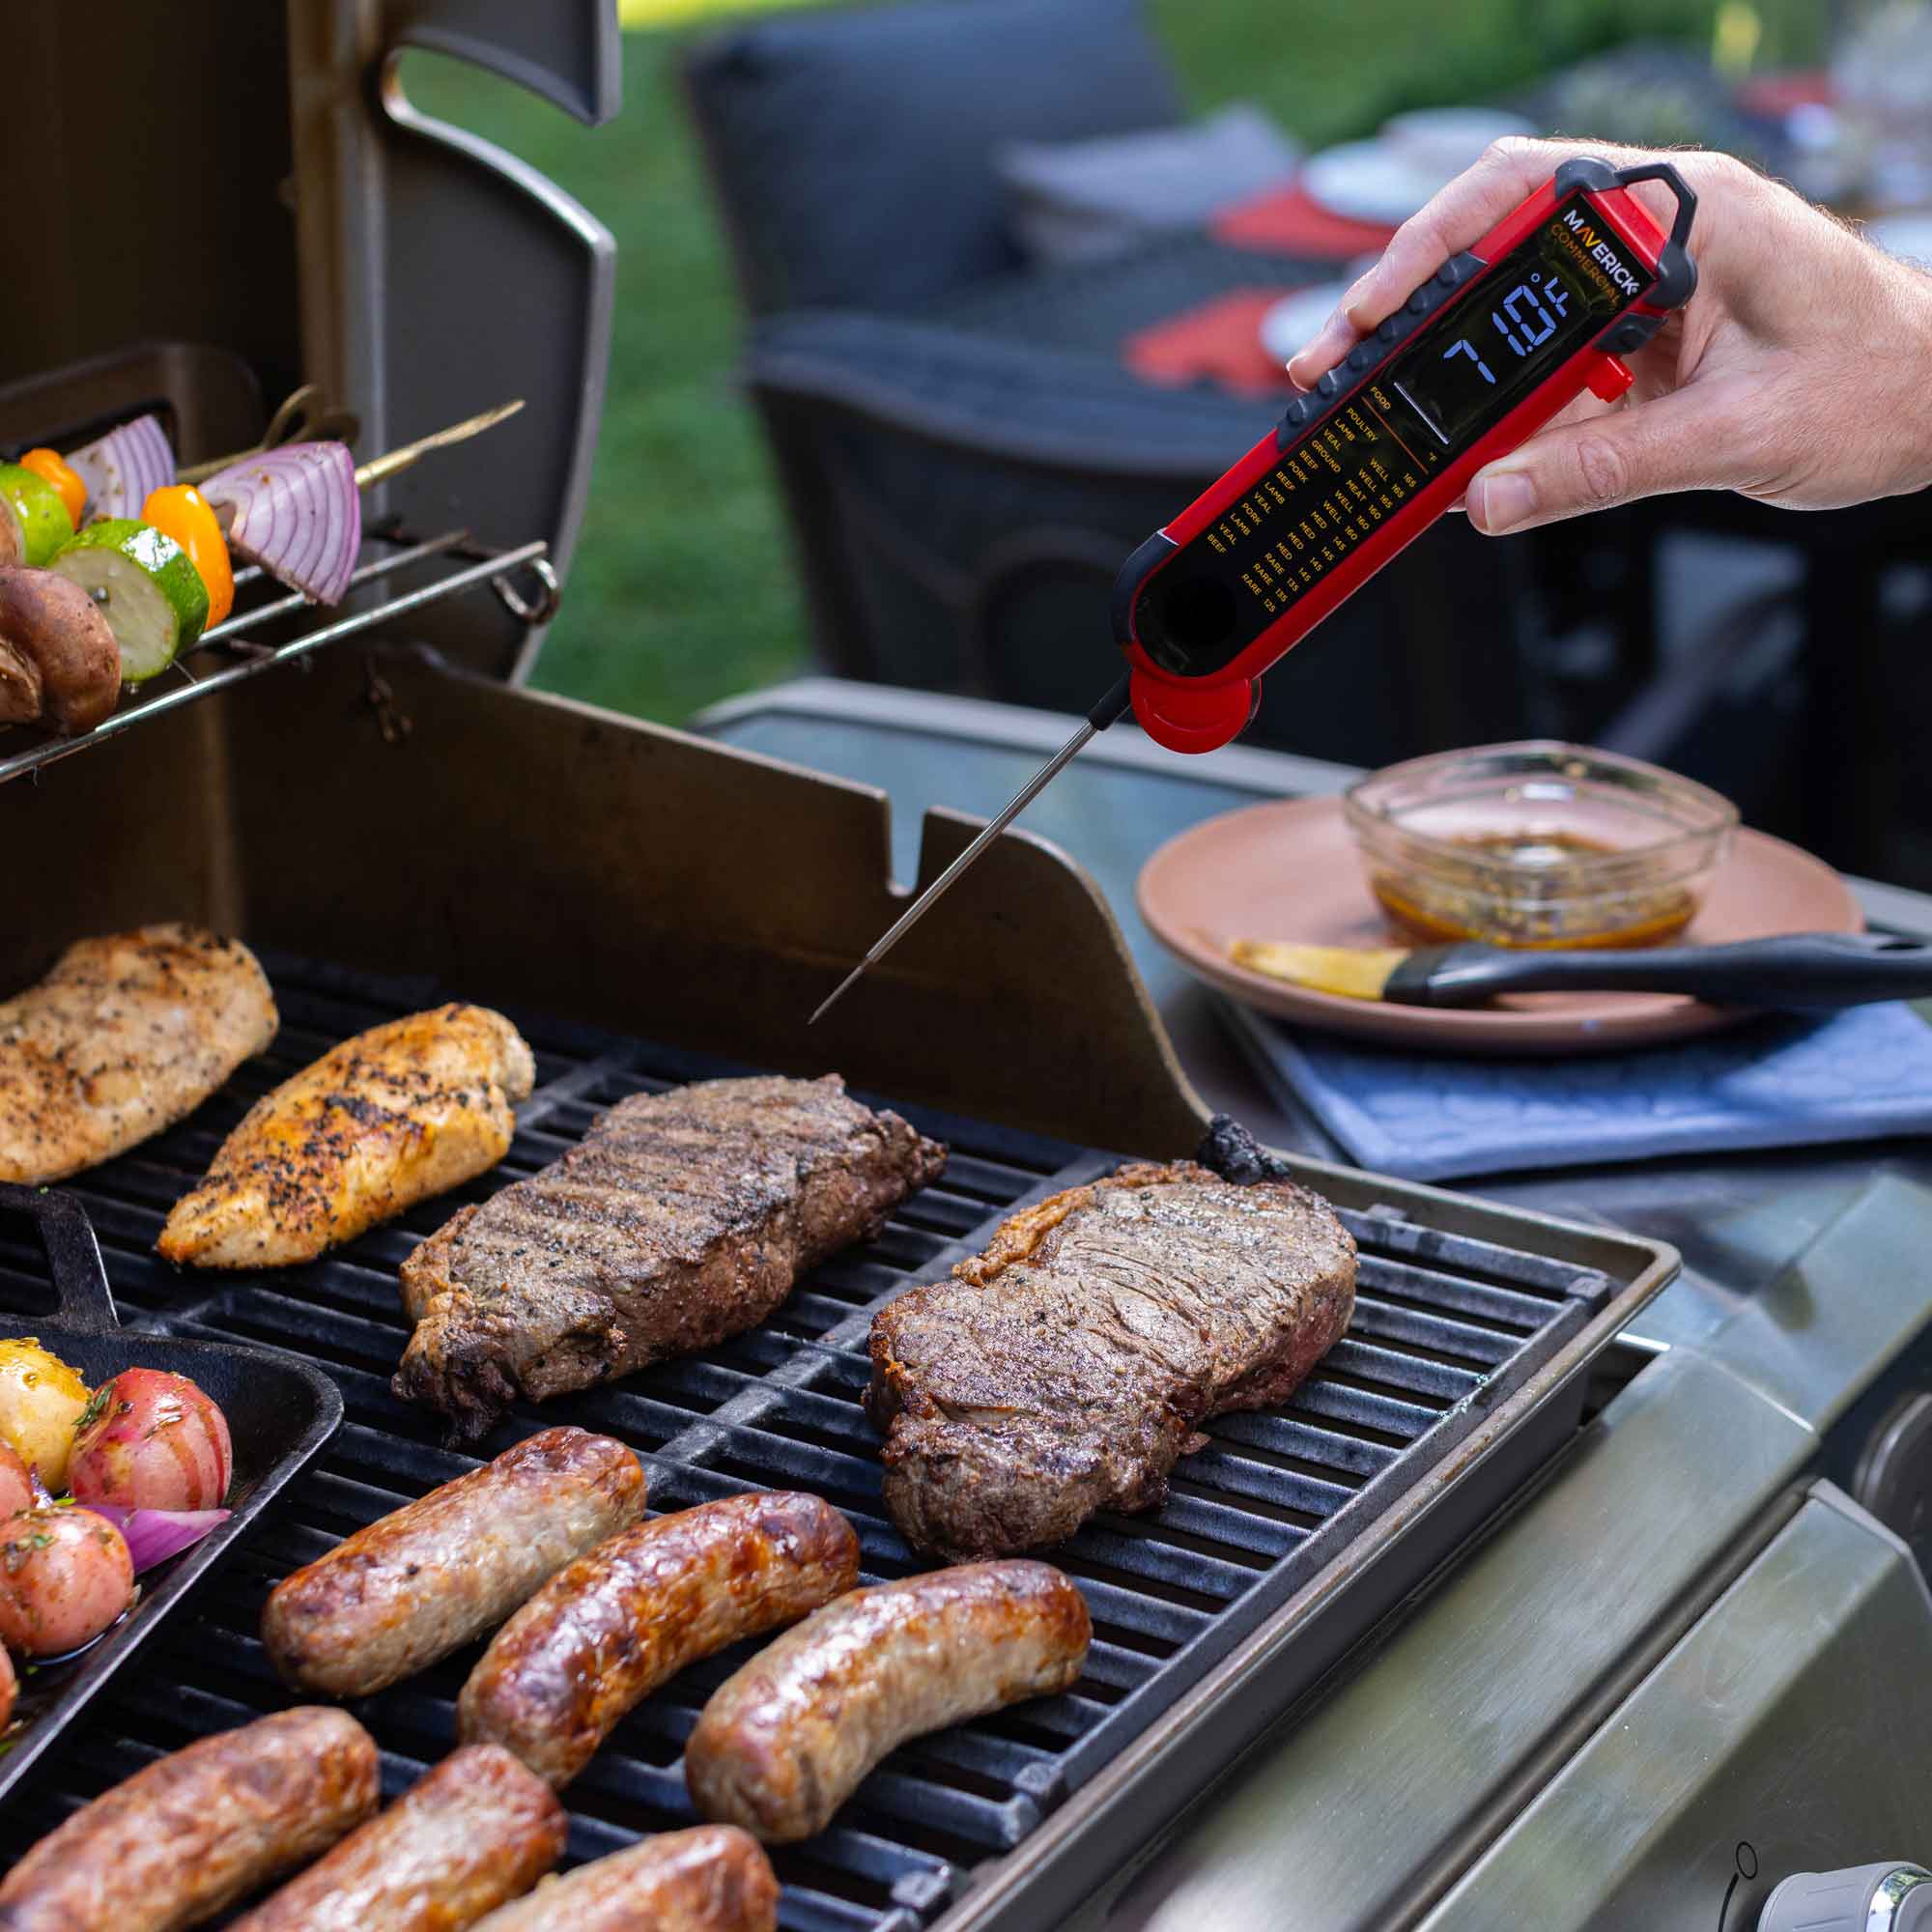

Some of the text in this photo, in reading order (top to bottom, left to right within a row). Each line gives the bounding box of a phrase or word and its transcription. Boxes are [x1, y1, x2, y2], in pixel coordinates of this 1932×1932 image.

[1551, 223, 1621, 308] COMMERCIAL
[1371, 386, 1392, 410] FOOD
[1312, 440, 1381, 520] GROUND MEAT 160
[1324, 429, 1393, 509] VEAL WELL 165
[1335, 419, 1405, 498] LAMB WELL 165
[1347, 408, 1417, 488] POULTRY 165
[1264, 482, 1335, 561] LAMB MED 145
[1276, 471, 1347, 552] BEEF MED 145
[1288, 461, 1358, 541] PORK WELL 160
[1299, 450, 1370, 530] BEEF WELL 160
[1220, 524, 1289, 603] VEAL RARE 135
[1232, 513, 1299, 592] LAMB RARE 135
[1242, 502, 1311, 582] PORK MED 145
[1255, 494, 1322, 571] VEAL MED 145
[1208, 534, 1276, 612] BEEF RARE 125
